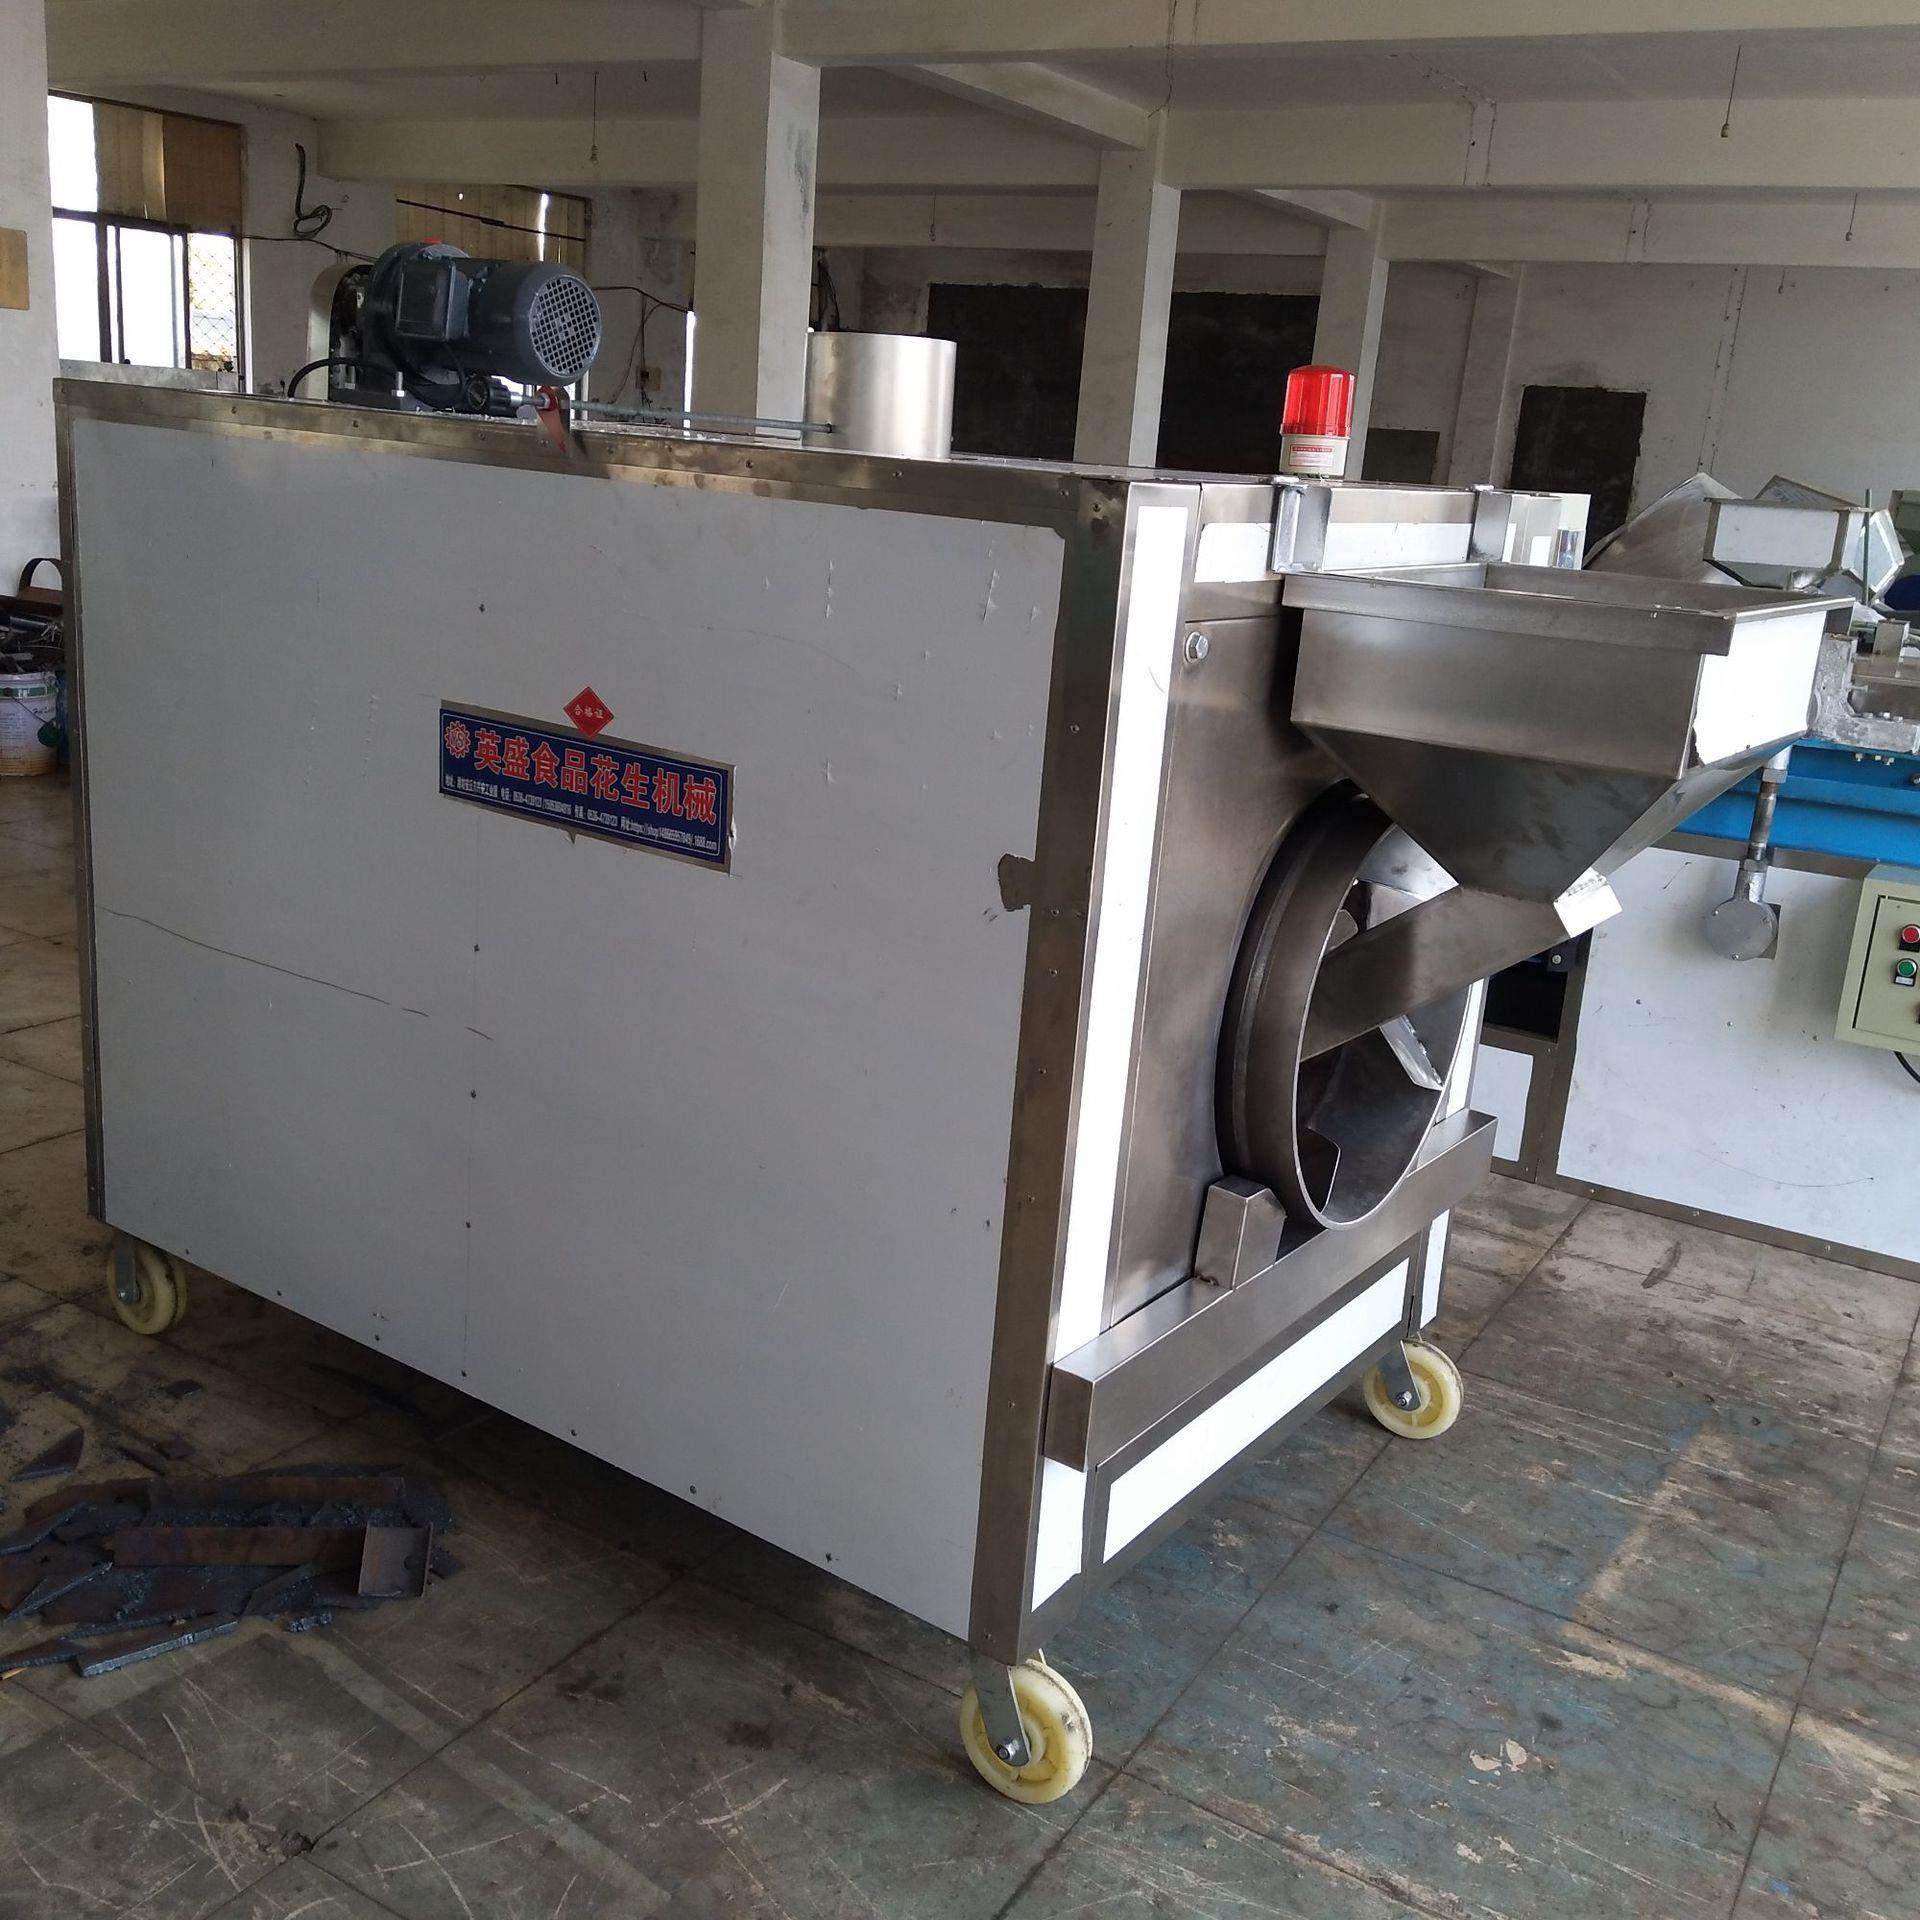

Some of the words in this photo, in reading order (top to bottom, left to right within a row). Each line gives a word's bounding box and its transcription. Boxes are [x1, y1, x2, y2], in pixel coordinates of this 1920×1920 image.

[574, 704, 604, 719] 合格证
[474, 727, 717, 825] 英盛食品花生机械
